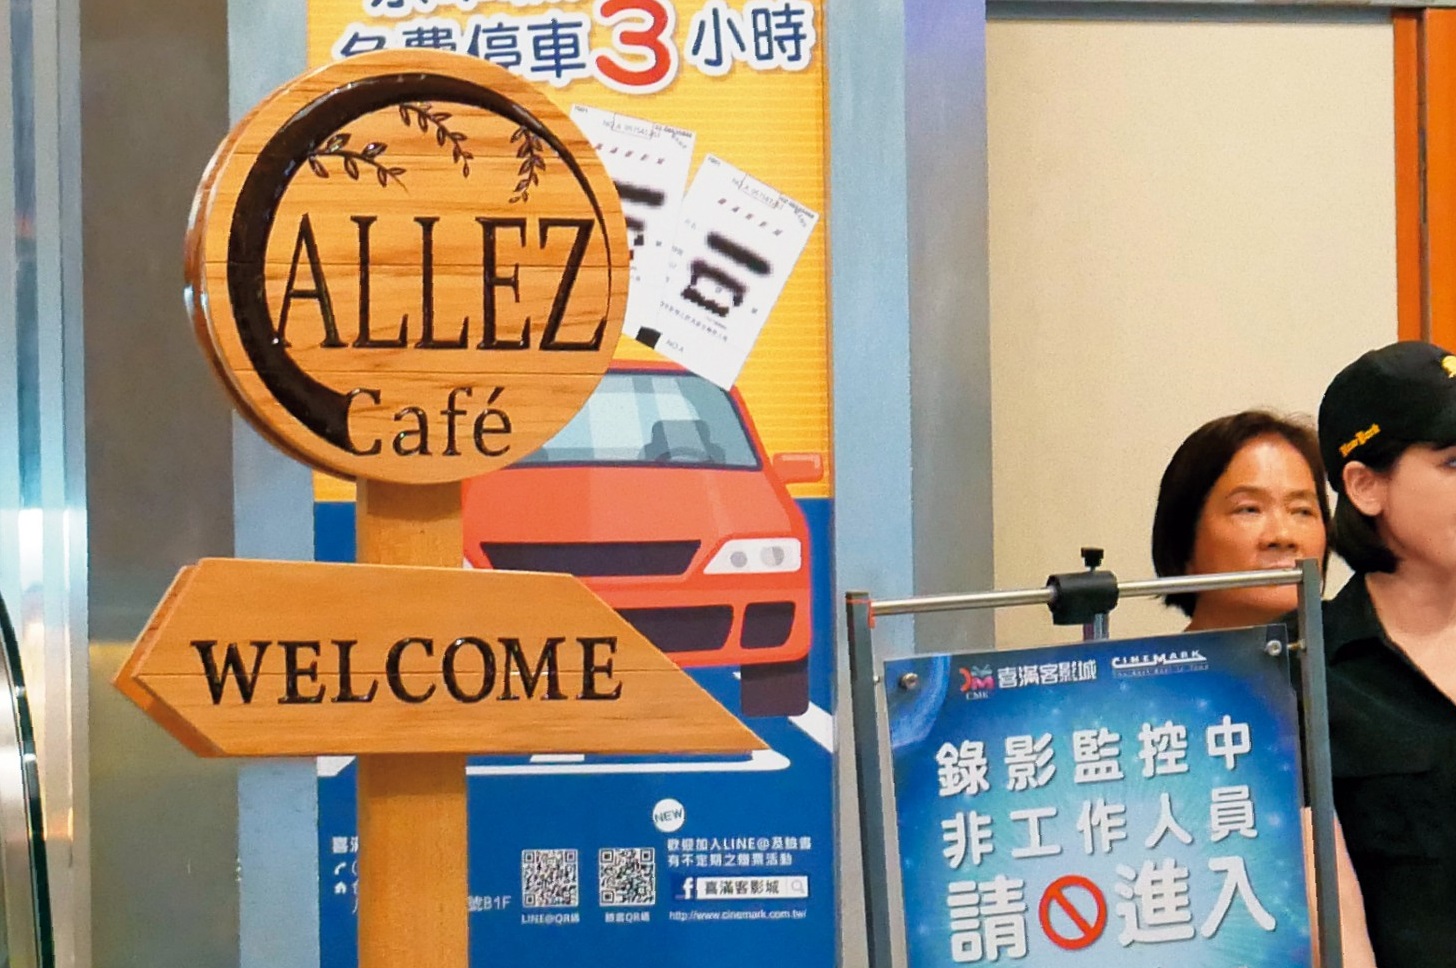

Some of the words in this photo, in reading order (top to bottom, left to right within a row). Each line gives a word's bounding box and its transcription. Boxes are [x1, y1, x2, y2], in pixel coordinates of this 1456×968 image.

[271, 212, 609, 352] ALLEZ
[344, 384, 512, 457] Café
[190, 636, 623, 705] WELCOME
[998, 660, 1097, 689] 喜滿客影城
[935, 715, 1252, 797] 錄影監控中
[655, 808, 683, 823] NEW
[941, 785, 1258, 868] 非工作人員
[946, 874, 1030, 963] 請
[1115, 855, 1277, 948] 進入
